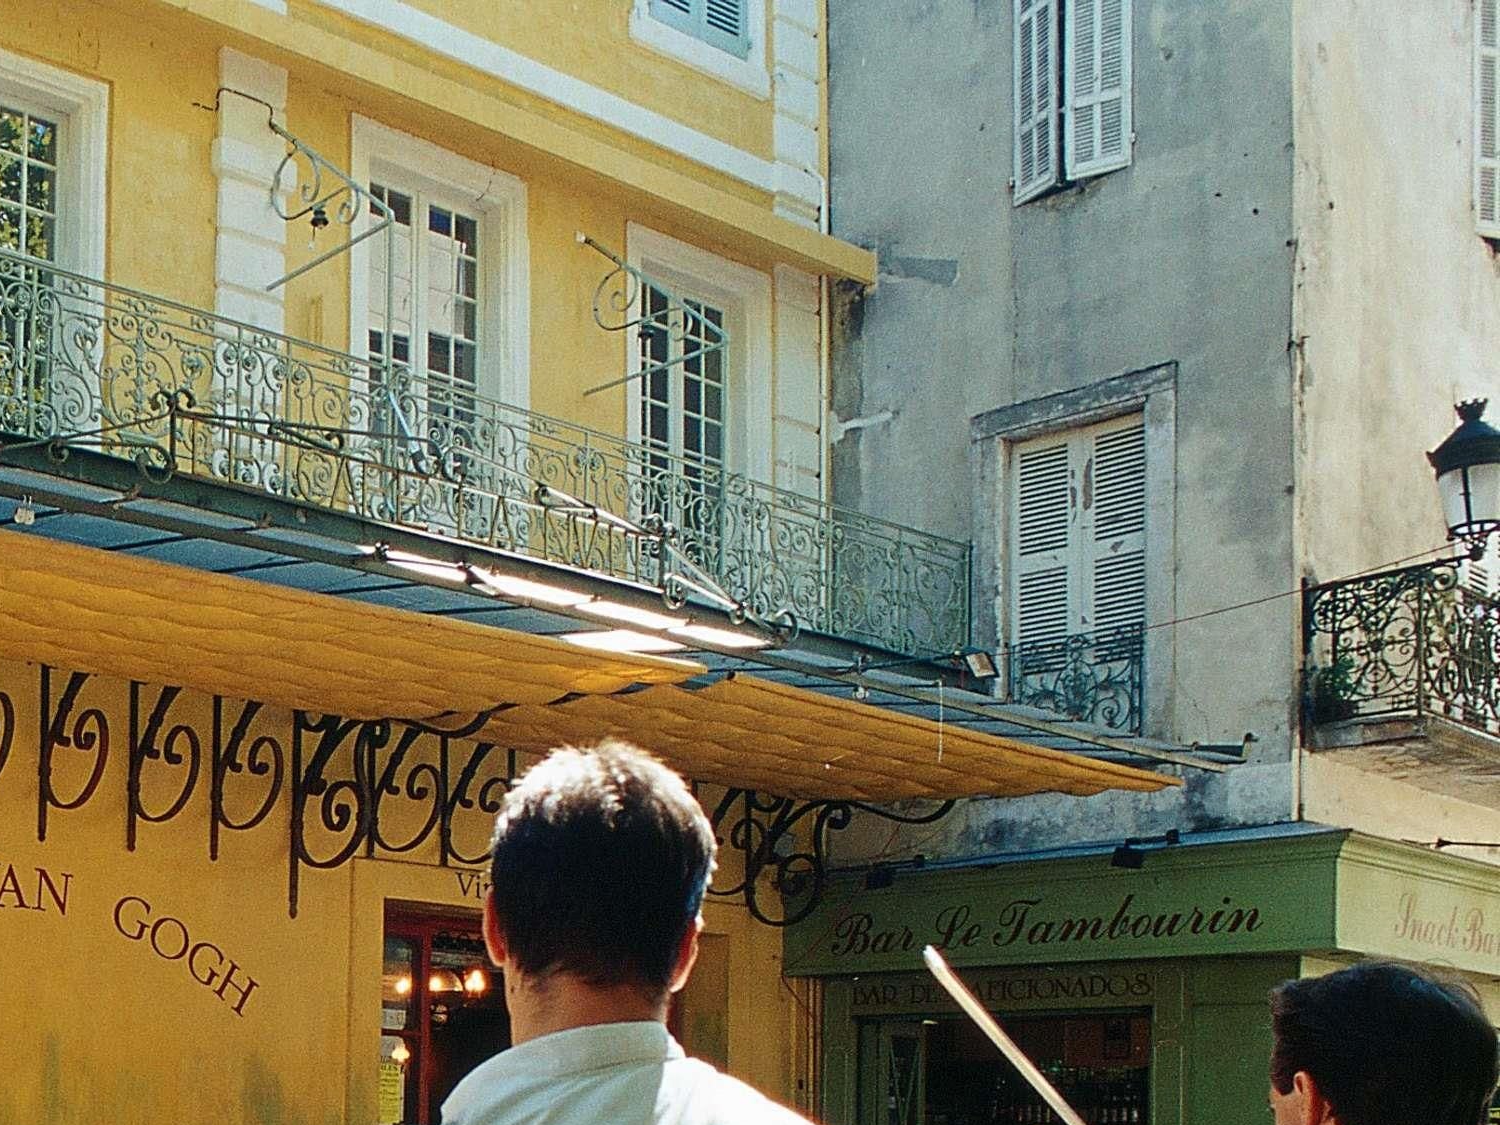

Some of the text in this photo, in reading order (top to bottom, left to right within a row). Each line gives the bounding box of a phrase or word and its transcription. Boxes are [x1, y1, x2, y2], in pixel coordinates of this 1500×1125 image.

[831, 893, 1264, 956] Bar Le Tambourin
[1394, 892, 1459, 949] Snack
[113, 895, 260, 1017] GOGH
